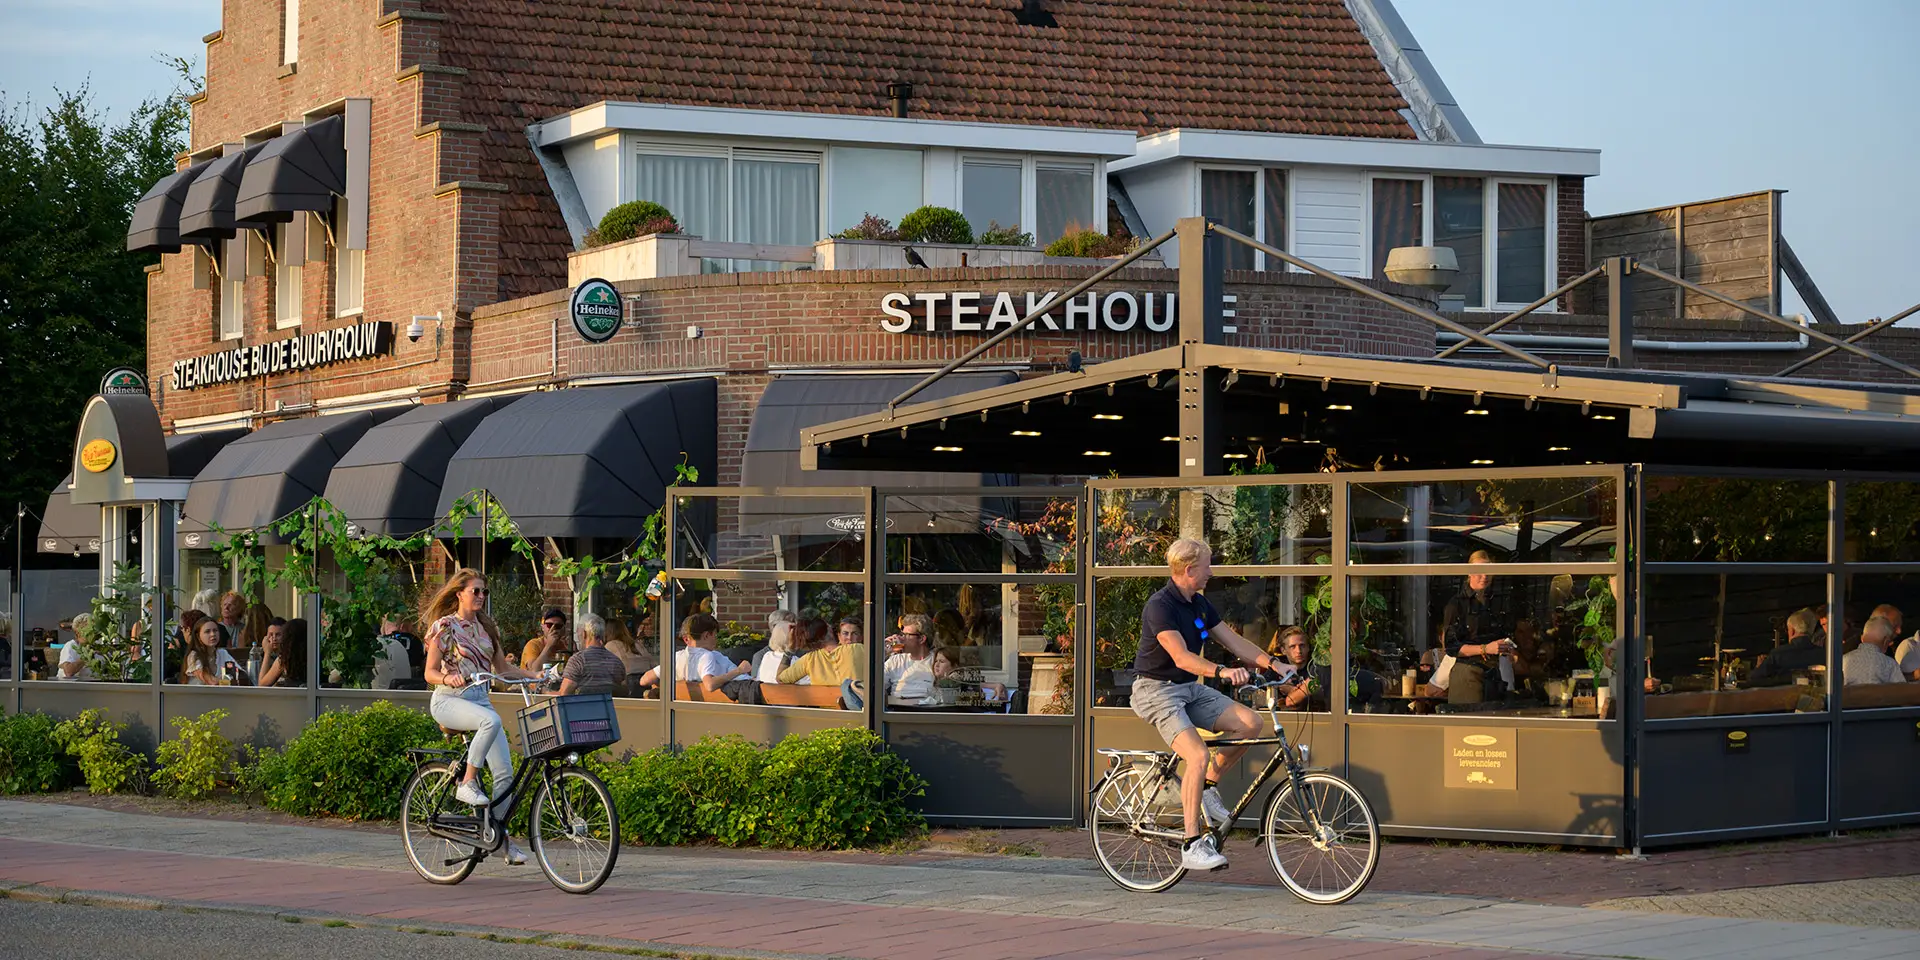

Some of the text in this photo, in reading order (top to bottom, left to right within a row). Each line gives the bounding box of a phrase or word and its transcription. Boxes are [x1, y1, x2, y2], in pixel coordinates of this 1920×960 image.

[880, 291, 1237, 334] STEAKHOUE
[172, 321, 379, 390] STEAKHOUSE BIJ DE BUURVROUW
[1453, 748, 1474, 757] Laden
[1485, 749, 1507, 758] lossen
[1459, 759, 1501, 768] leveranciers
